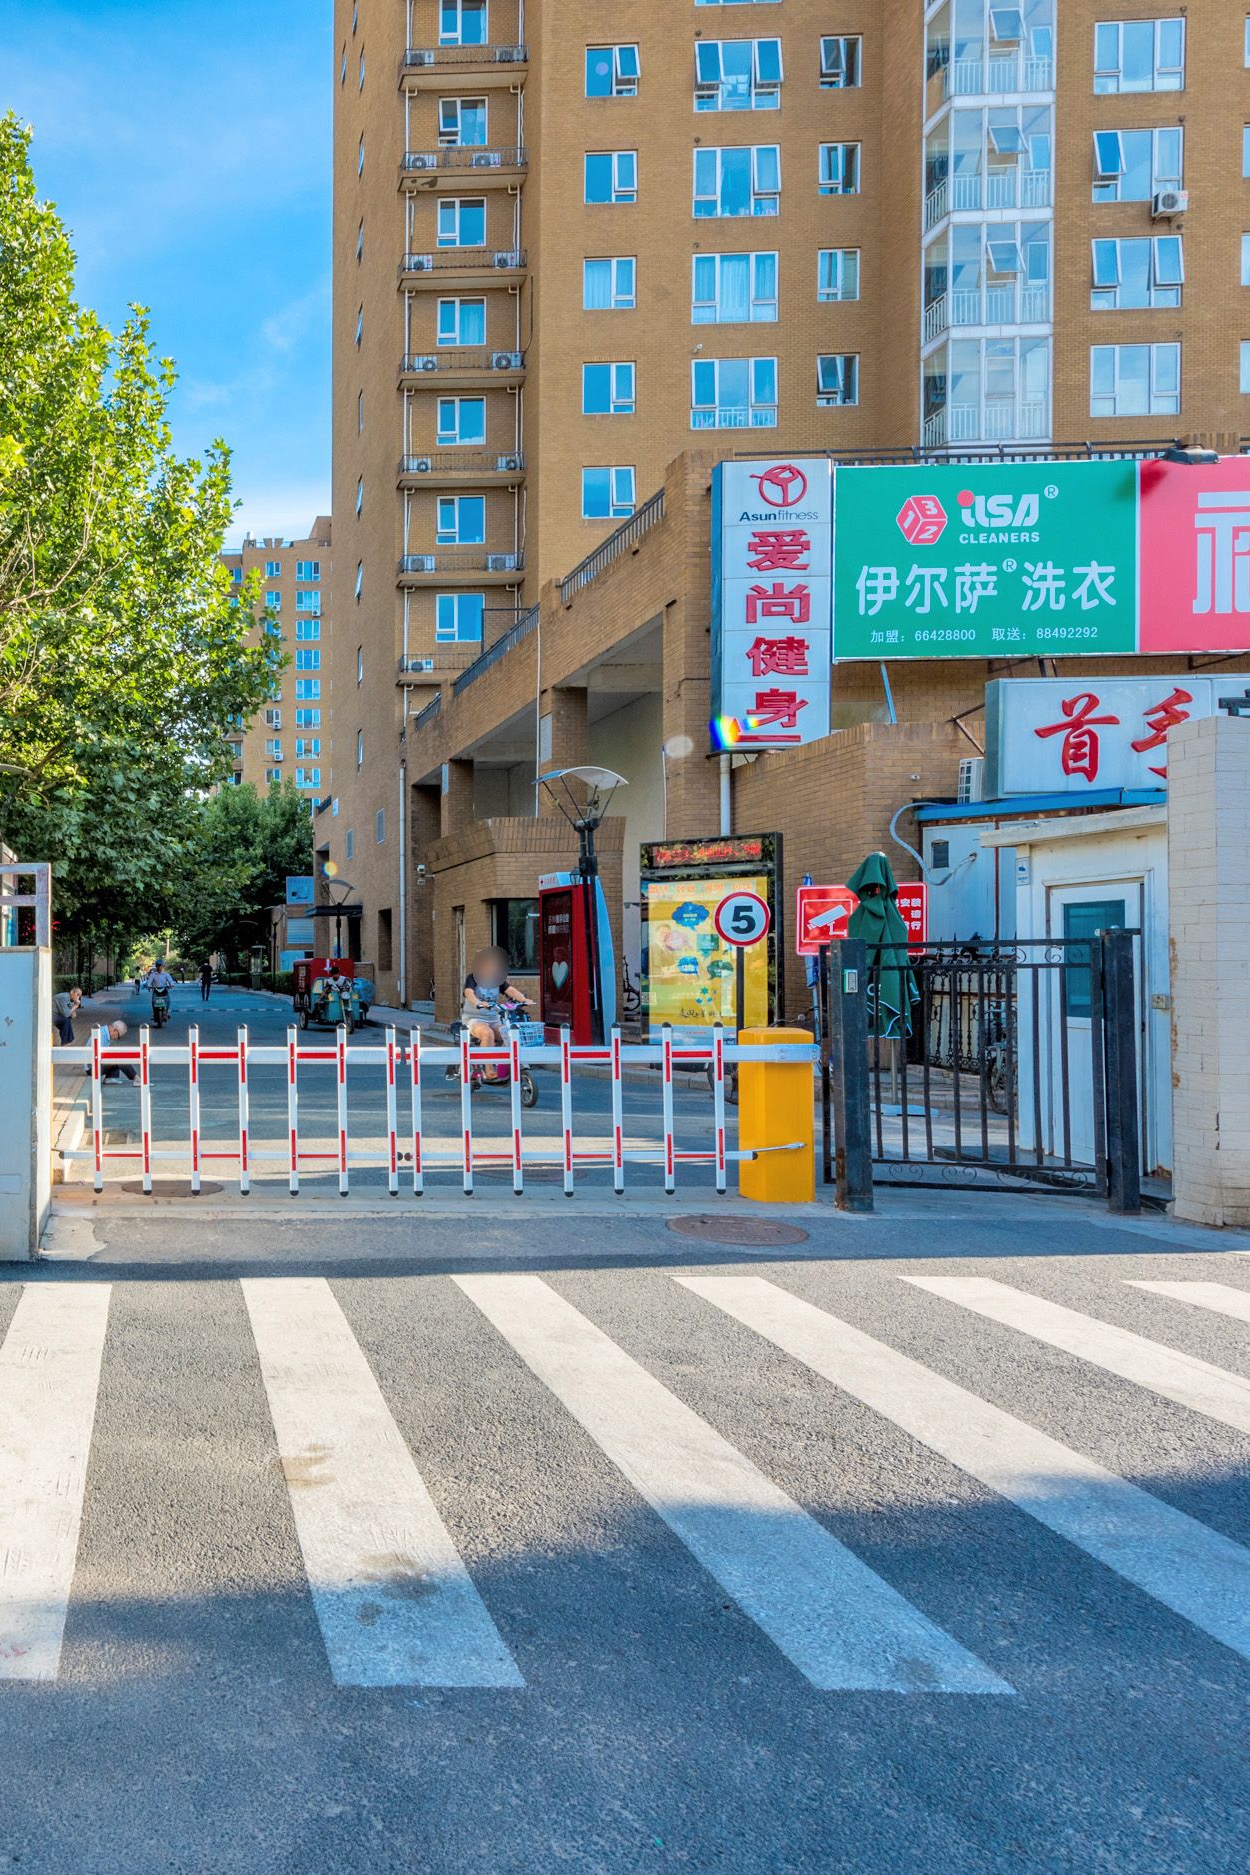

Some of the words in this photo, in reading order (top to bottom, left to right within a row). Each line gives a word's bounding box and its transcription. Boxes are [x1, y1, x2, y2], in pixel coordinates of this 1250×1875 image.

[958, 531, 1041, 545] CLEANERS
[746, 529, 810, 729] 爱尚健身
[914, 629, 976, 642] 66428800
[1036, 626, 1098, 639] 88492292
[731, 905, 757, 935] 5
